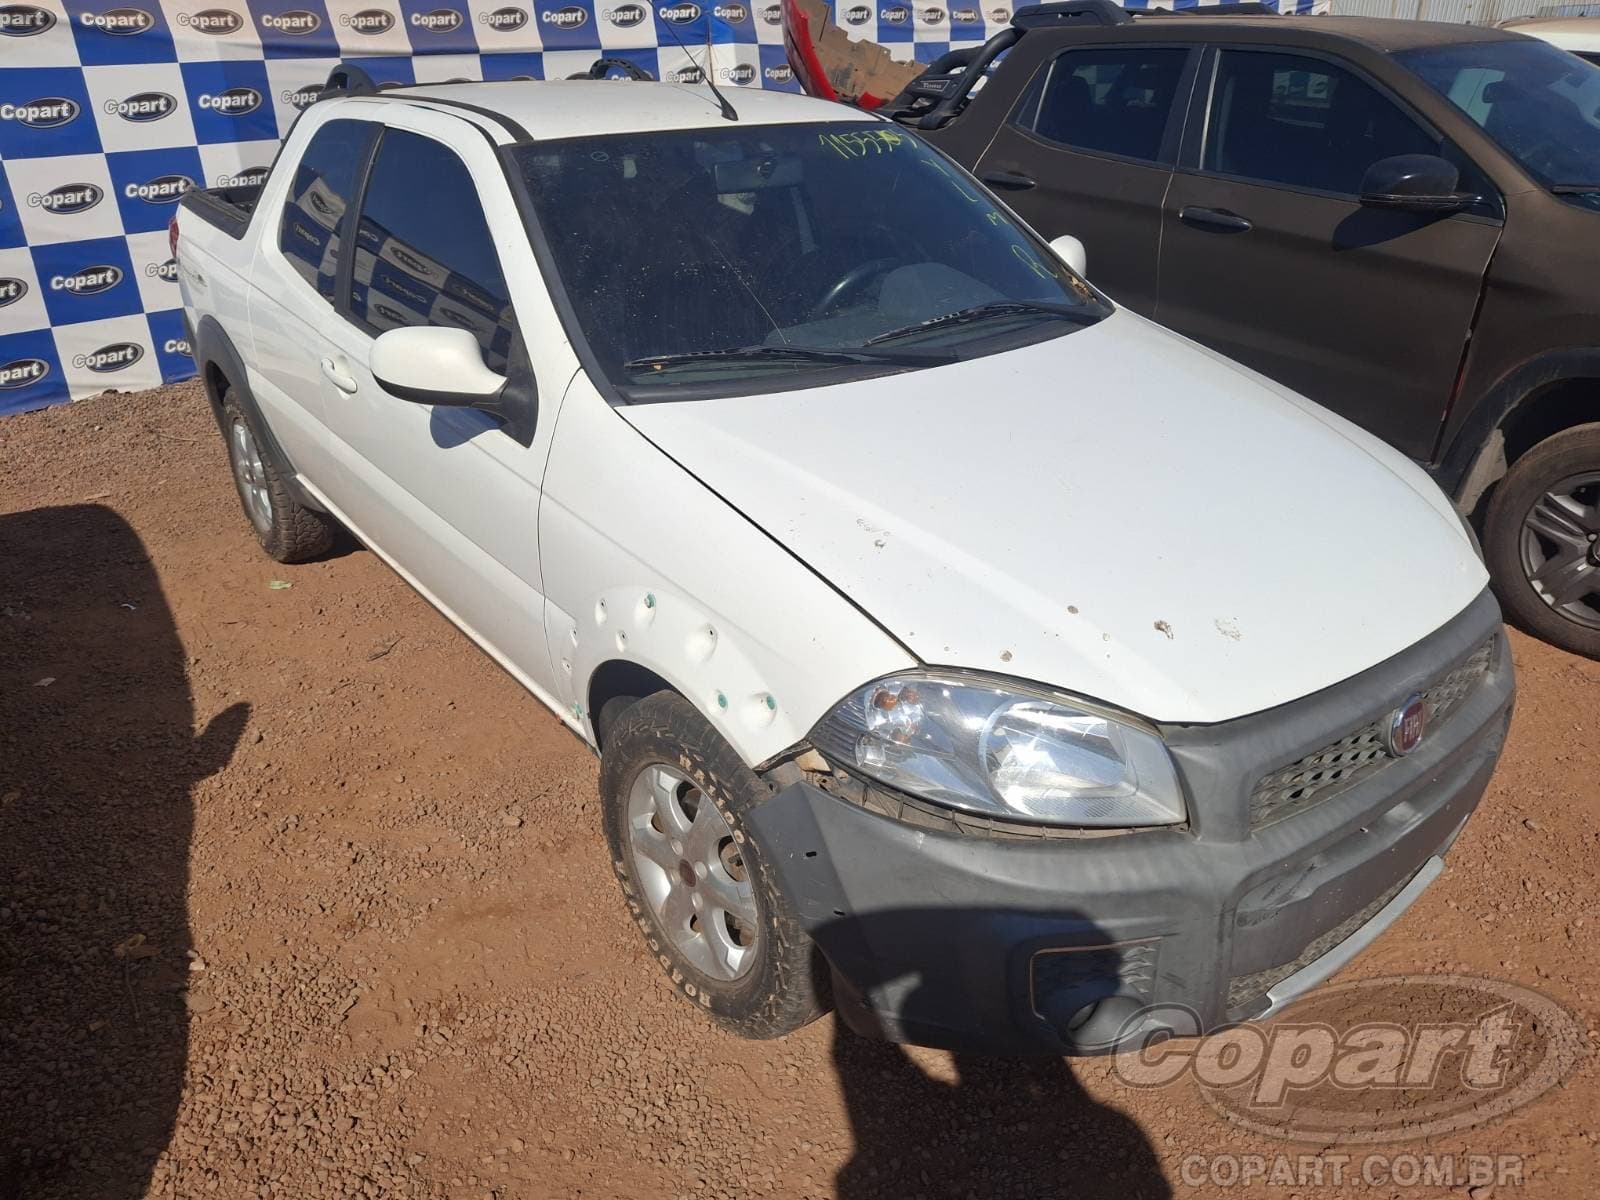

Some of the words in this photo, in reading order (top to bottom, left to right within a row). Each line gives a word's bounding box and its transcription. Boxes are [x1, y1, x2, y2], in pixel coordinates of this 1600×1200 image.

[411, 13, 456, 27] Copart
[479, 12, 521, 25] Copart
[543, 10, 582, 25] Copart
[602, 9, 640, 22] Copart
[659, 7, 695, 20] Copart
[714, 7, 743, 18] Copart
[758, 8, 781, 19] Copar
[841, 9, 867, 20] Copart
[881, 9, 905, 20] Copart
[953, 11, 976, 20] Copart
[81, 13, 146, 29] Copart
[178, 13, 234, 28] Copart
[262, 14, 313, 29] Copart
[340, 13, 387, 28] Copart
[720, 68, 751, 81] Copart
[764, 67, 790, 80] Copart
[198, 93, 254, 111] Copart
[281, 90, 318, 106] Copa
[1, 102, 69, 122] Copart
[105, 99, 167, 117] Copart
[125, 179, 186, 199] Copart
[27, 188, 92, 208] Copart
[51, 268, 114, 290] Copart
[73, 346, 134, 368] Copart
